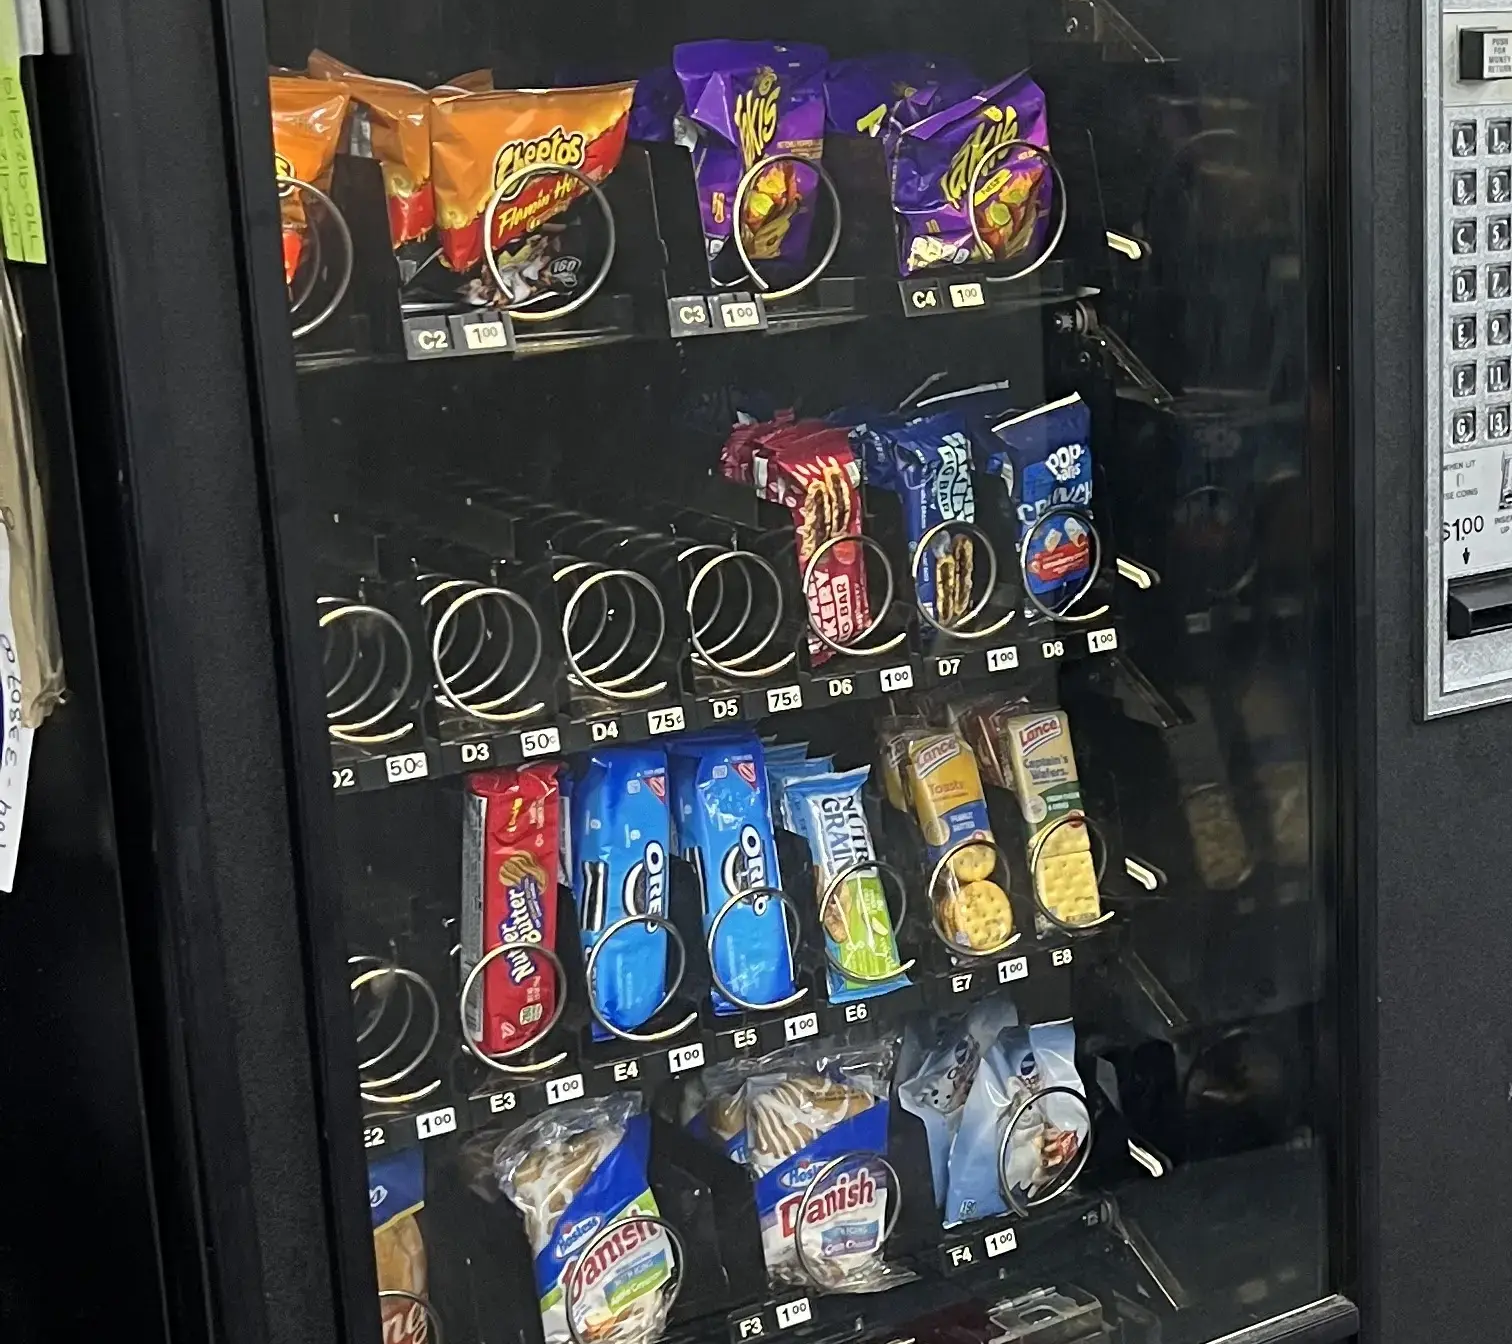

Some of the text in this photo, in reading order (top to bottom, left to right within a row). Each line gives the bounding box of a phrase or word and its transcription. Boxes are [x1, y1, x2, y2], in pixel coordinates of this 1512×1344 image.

[495, 128, 583, 197] Cheetos
[553, 259, 577, 274] 160
[1456, 276, 1466, 294] D
[1492, 272, 1500, 291] 7
[912, 291, 937, 309] C4
[679, 306, 706, 324] C3
[418, 329, 449, 350] C2
[1457, 324, 1466, 342] E
[1491, 320, 1500, 338] 9
[1458, 371, 1466, 389] F
[1490, 367, 1502, 386] 11
[1456, 418, 1467, 437] G
[1489, 414, 1502, 433] 13
[1042, 641, 1065, 657] D8
[938, 659, 961, 676] D7
[828, 678, 853, 696] D6
[712, 692, 800, 718] D5 75¢
[592, 713, 682, 741] D4 75¢
[1019, 719, 1058, 747] Lance
[461, 734, 558, 763] D3 50¢
[389, 759, 424, 777] 50¢
[821, 797, 854, 876] GRAIN
[1051, 949, 1073, 966] E8
[952, 975, 974, 993] E7
[845, 1004, 868, 1022] E6
[733, 1030, 758, 1049] E5
[613, 1062, 640, 1081] E4
[490, 1093, 517, 1113] E3
[779, 1170, 875, 1238] Danish
[951, 1247, 973, 1266] F4
[739, 1319, 764, 1337] F3
